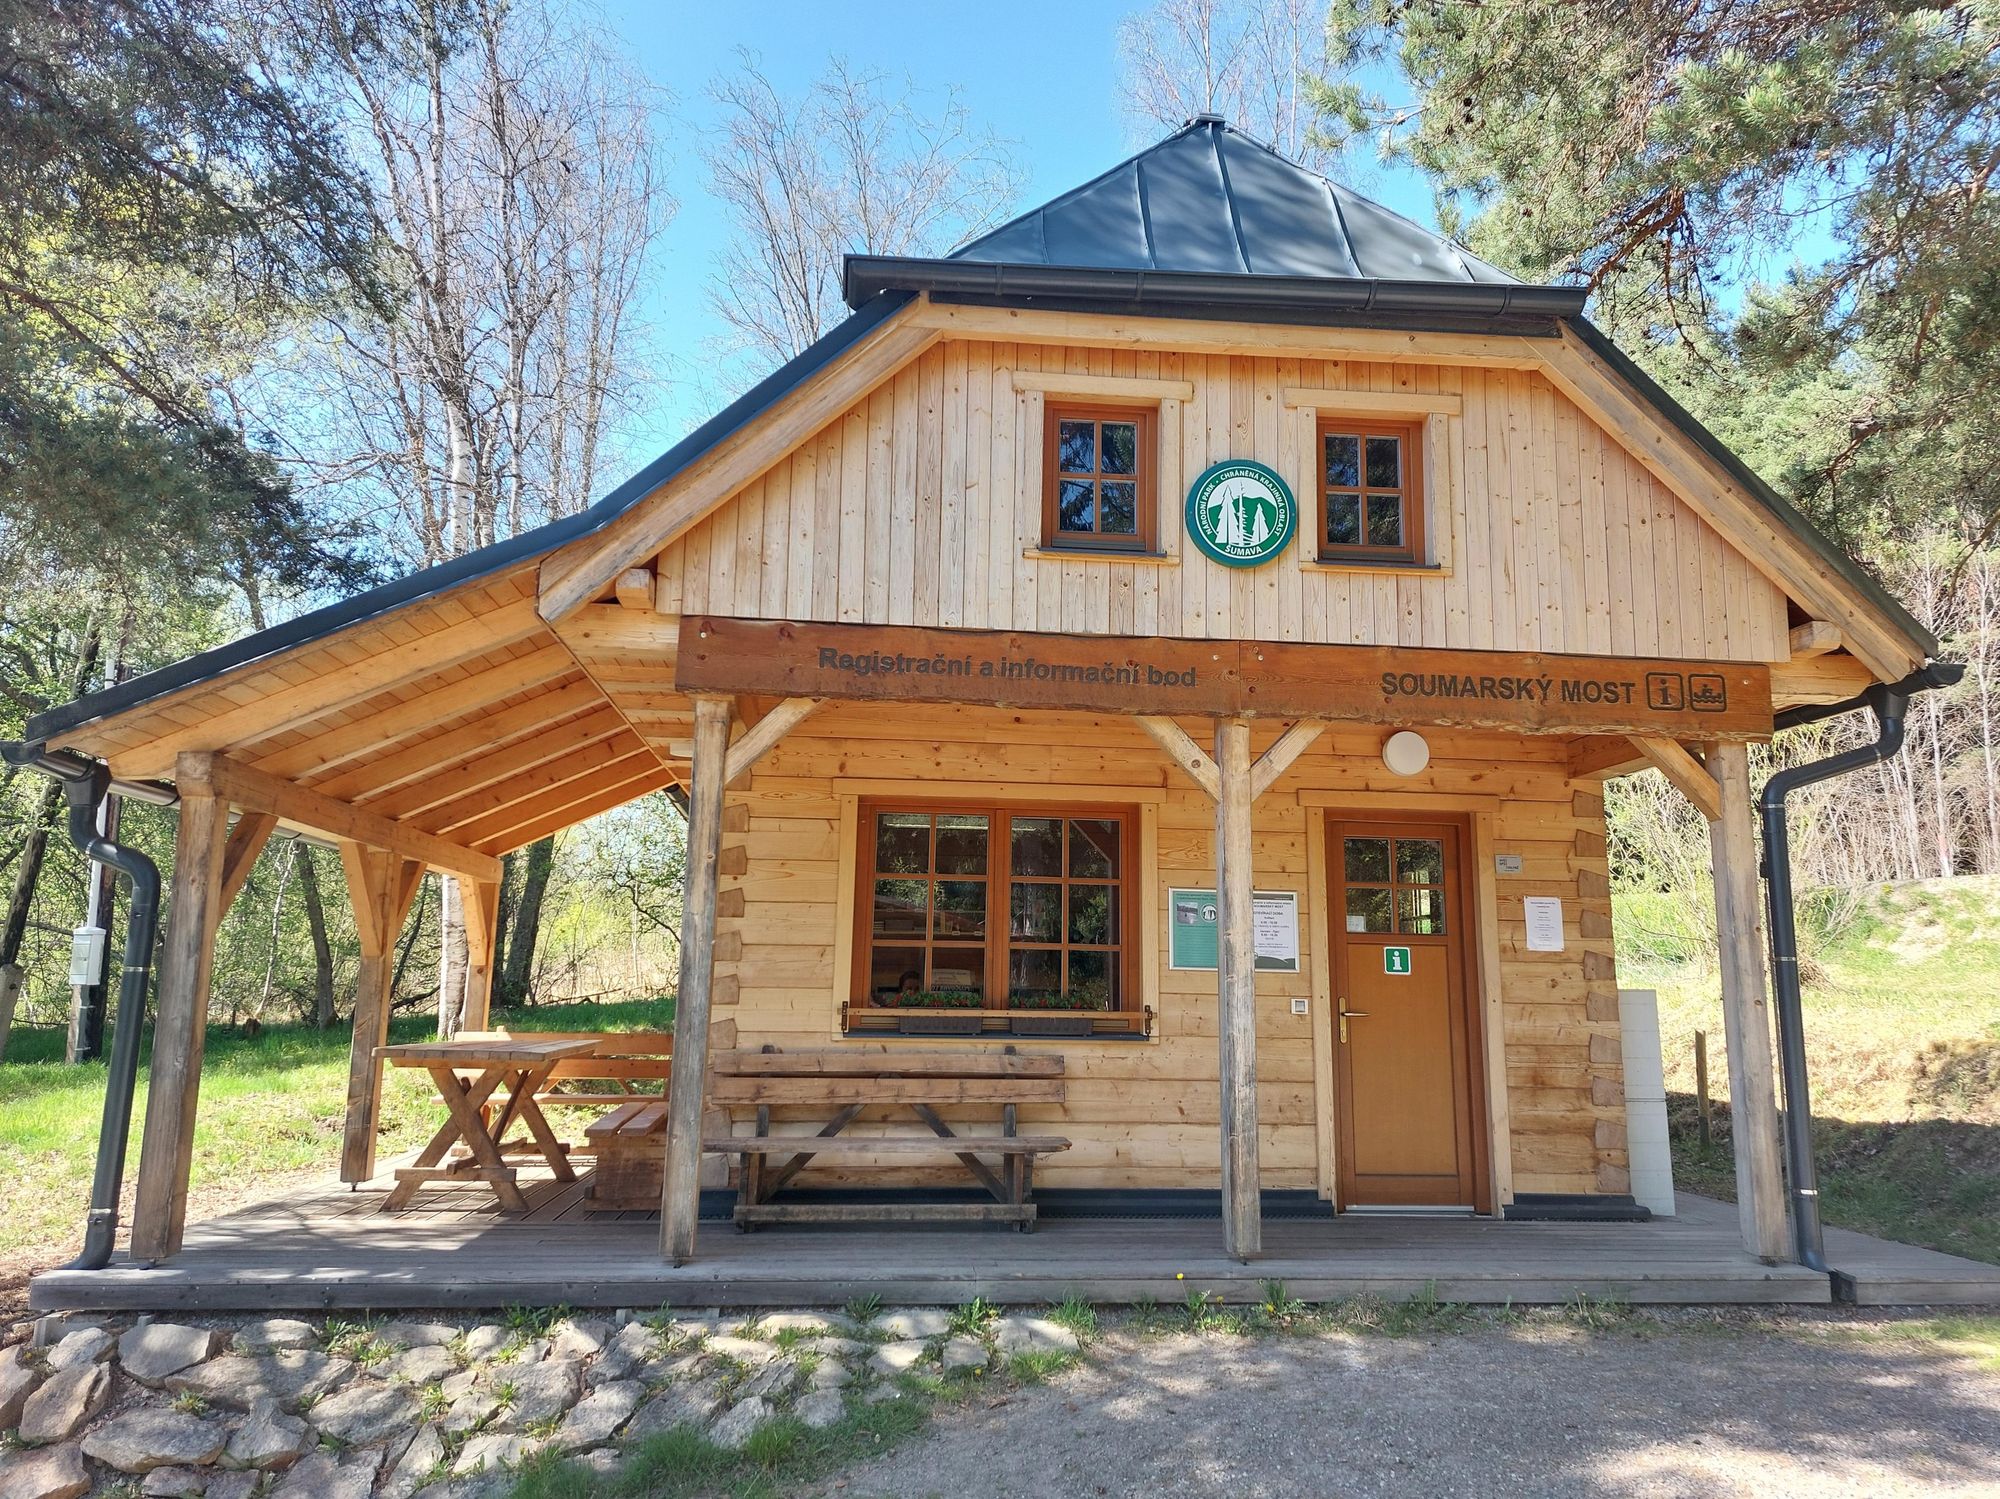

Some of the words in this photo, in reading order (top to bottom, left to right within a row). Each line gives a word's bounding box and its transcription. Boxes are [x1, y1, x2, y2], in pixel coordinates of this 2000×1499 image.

[1220, 469, 1259, 481] CHRÁNĚNÁ
[1203, 483, 1215, 501] PARK
[1259, 477, 1284, 508] KRAJINNÁ
[1199, 501, 1212, 535] NÁRODNÍ
[1274, 508, 1286, 537] OBLAST
[818, 647, 972, 677] Registrační
[980, 663, 994, 676] a
[1000, 656, 1139, 685] informační
[1147, 665, 1197, 687] bod
[1381, 672, 1553, 702] SOUMARSKÝ
[1560, 679, 1636, 704] MOST
